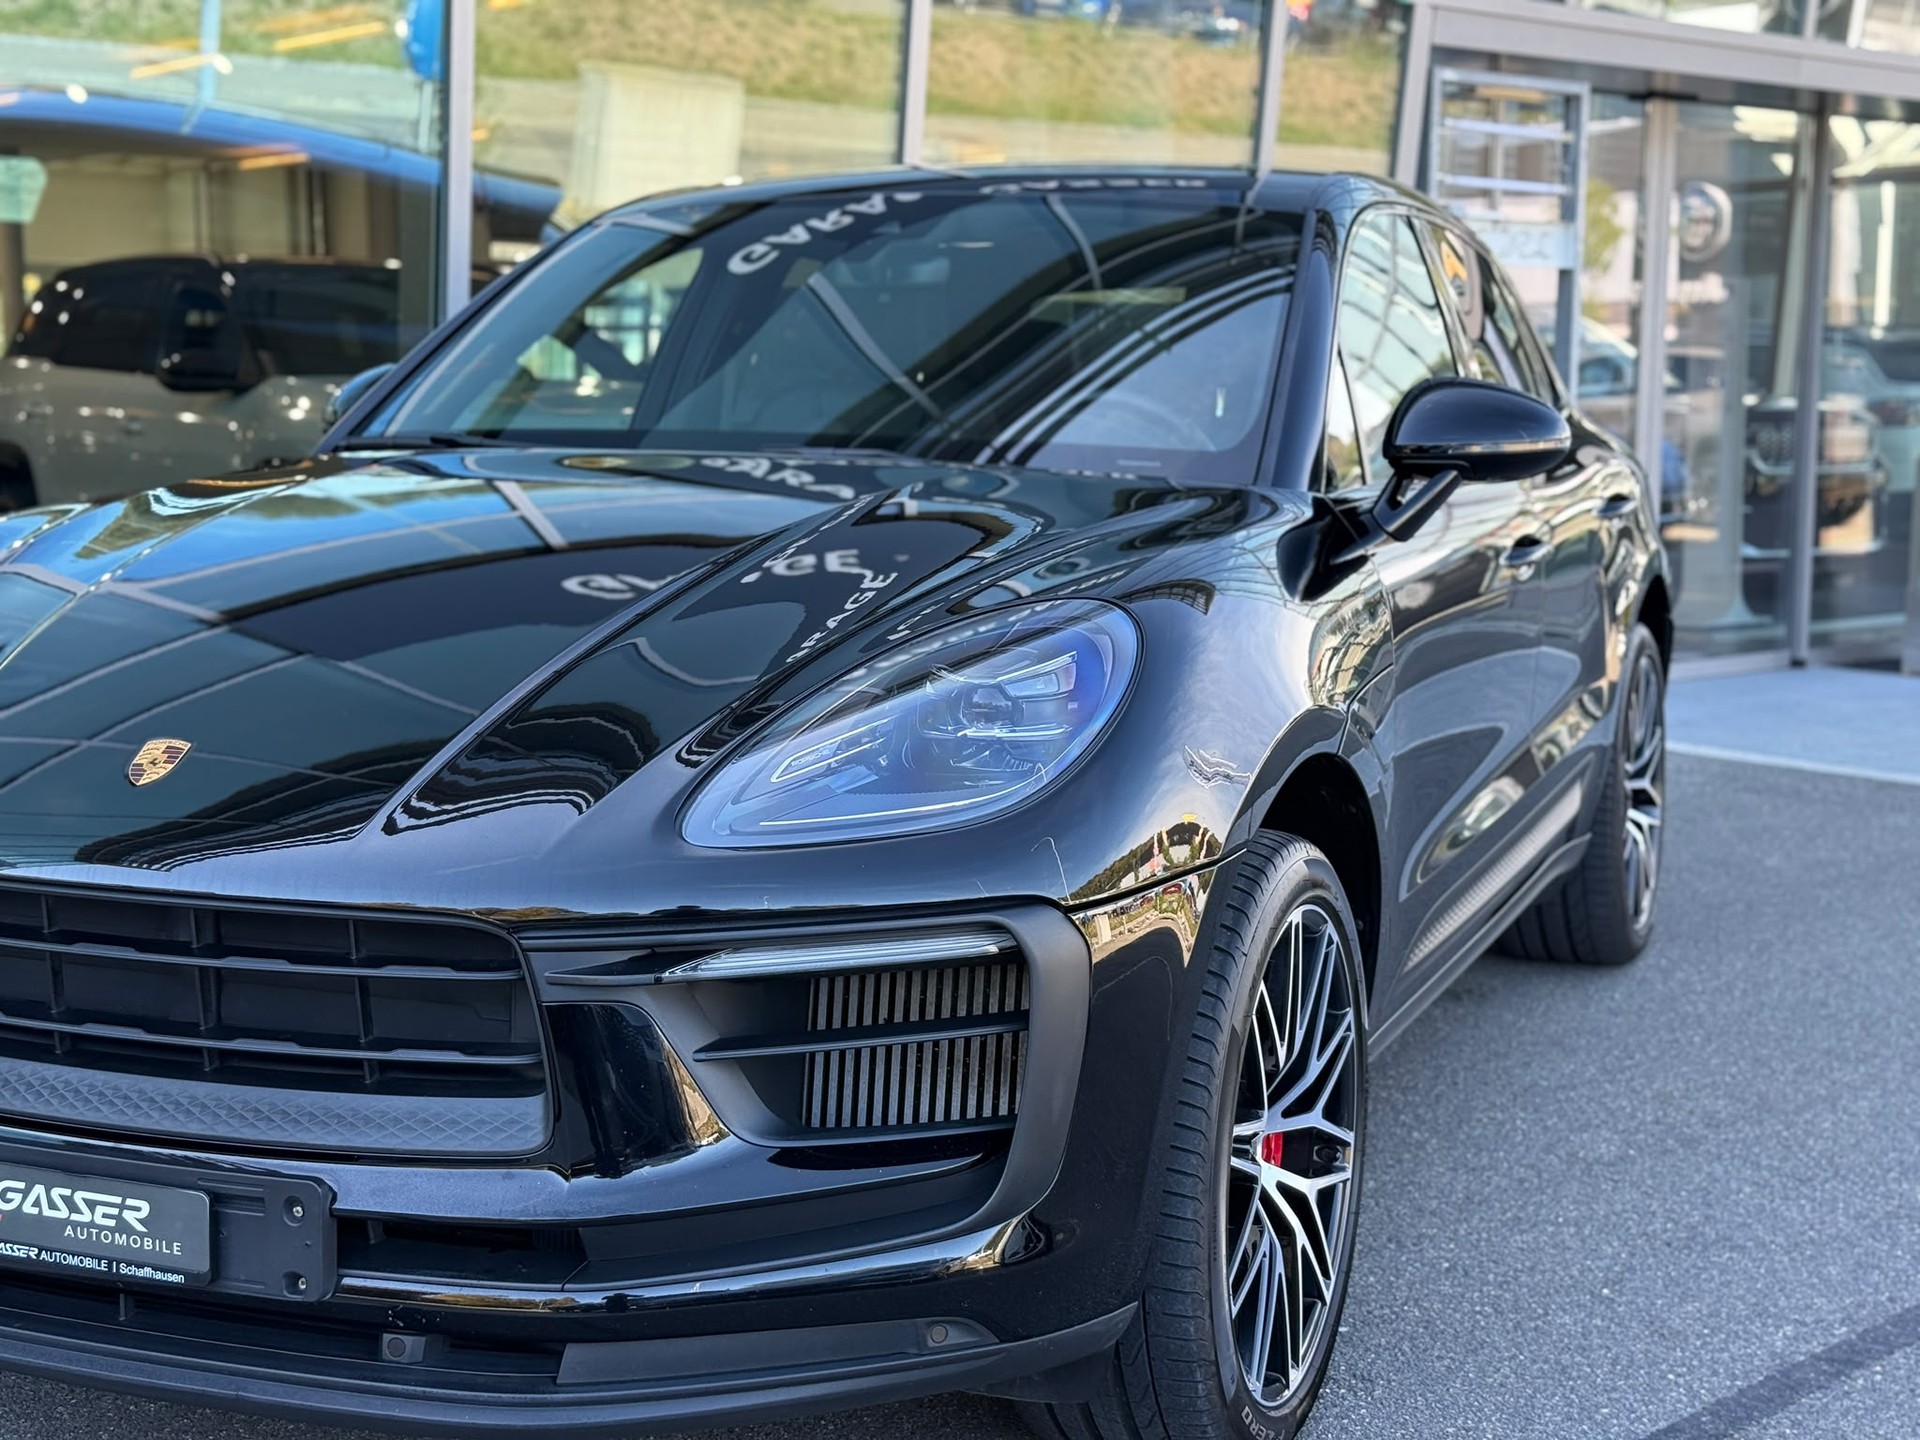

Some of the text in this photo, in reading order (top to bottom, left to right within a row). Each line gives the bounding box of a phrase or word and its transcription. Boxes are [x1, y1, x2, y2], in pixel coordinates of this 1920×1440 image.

[0, 1180, 150, 1232] GASSER
[64, 1225, 182, 1255] AUTOMOBILE
[0, 1242, 39, 1259] ASSER
[40, 1250, 108, 1271] AUTOMOBILE
[119, 1264, 185, 1284] Schaffhausen
